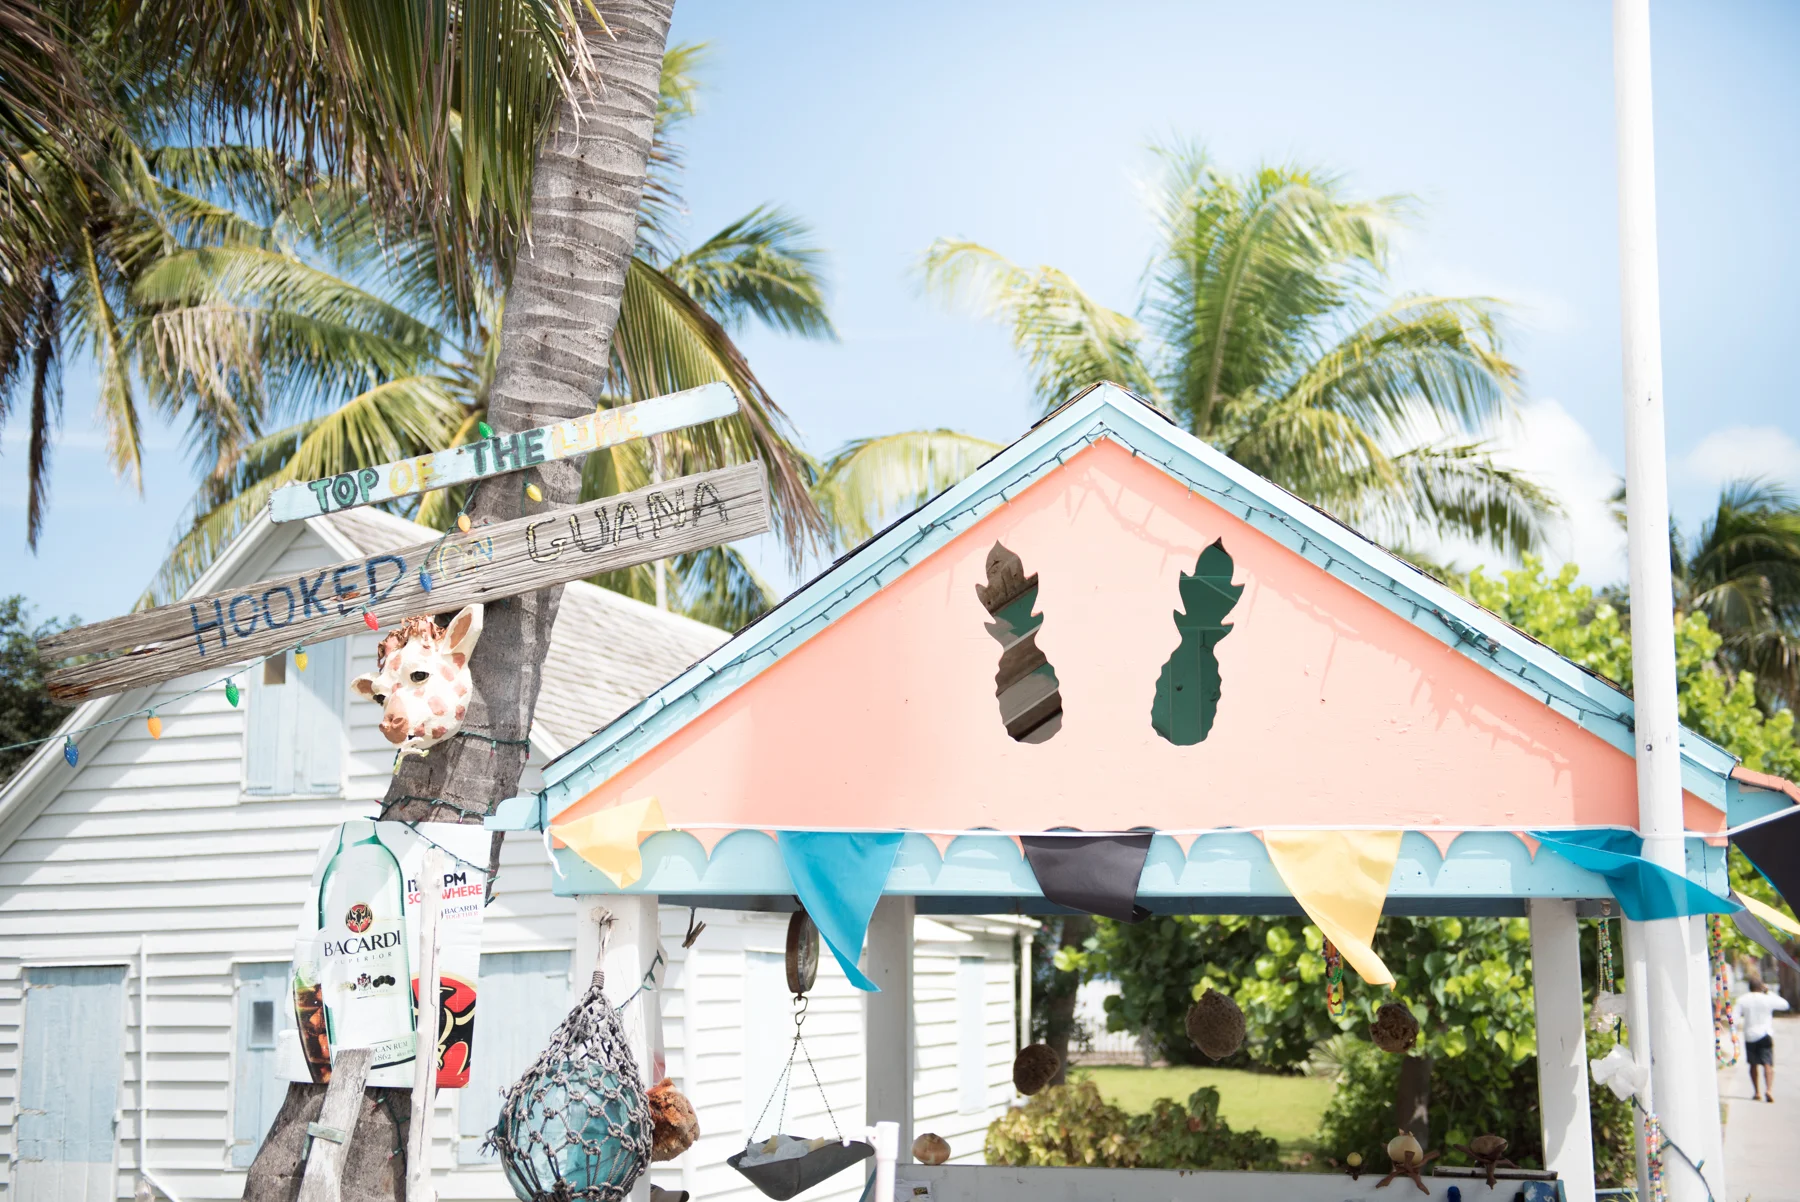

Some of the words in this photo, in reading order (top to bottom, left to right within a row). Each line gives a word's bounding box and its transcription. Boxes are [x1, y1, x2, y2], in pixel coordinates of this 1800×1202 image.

[308, 467, 379, 513] TOP
[389, 453, 436, 496] OF
[465, 428, 545, 475] THE
[190, 554, 408, 656] HOOKED
[525, 481, 729, 563] GUANA
[407, 884, 483, 905] SOWHERE
[444, 904, 479, 915] BACARDI
[324, 930, 402, 957] BACARDI
[334, 951, 392, 965] SUPERIOR
[374, 1053, 392, 1062] 1862
